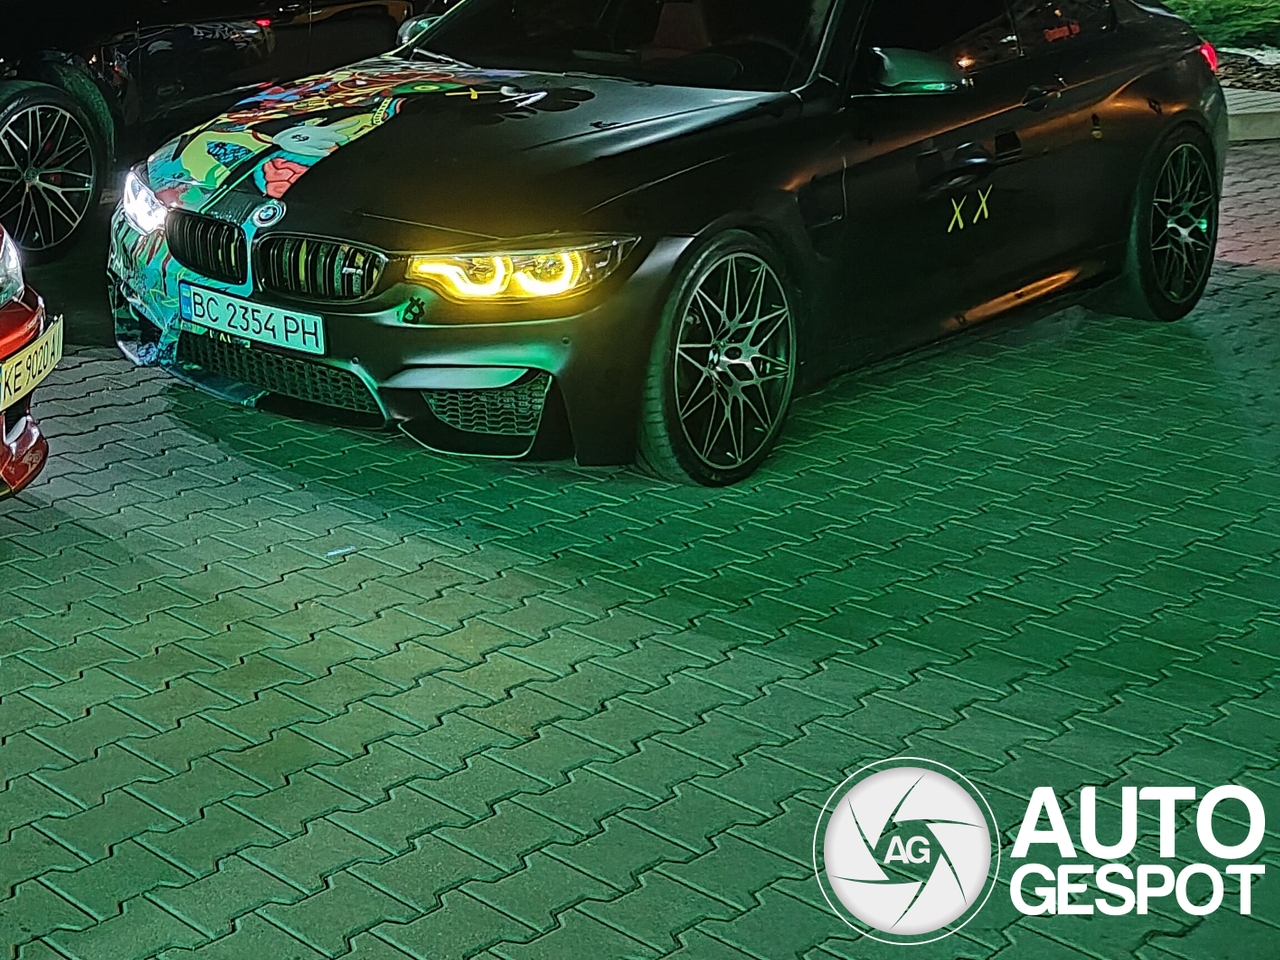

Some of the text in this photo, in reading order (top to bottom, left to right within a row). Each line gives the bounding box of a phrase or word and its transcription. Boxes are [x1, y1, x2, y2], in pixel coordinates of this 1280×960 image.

[192, 292, 320, 349] BC 2354 PH
[3, 361, 23, 401] KE
[25, 340, 49, 386] 9020
